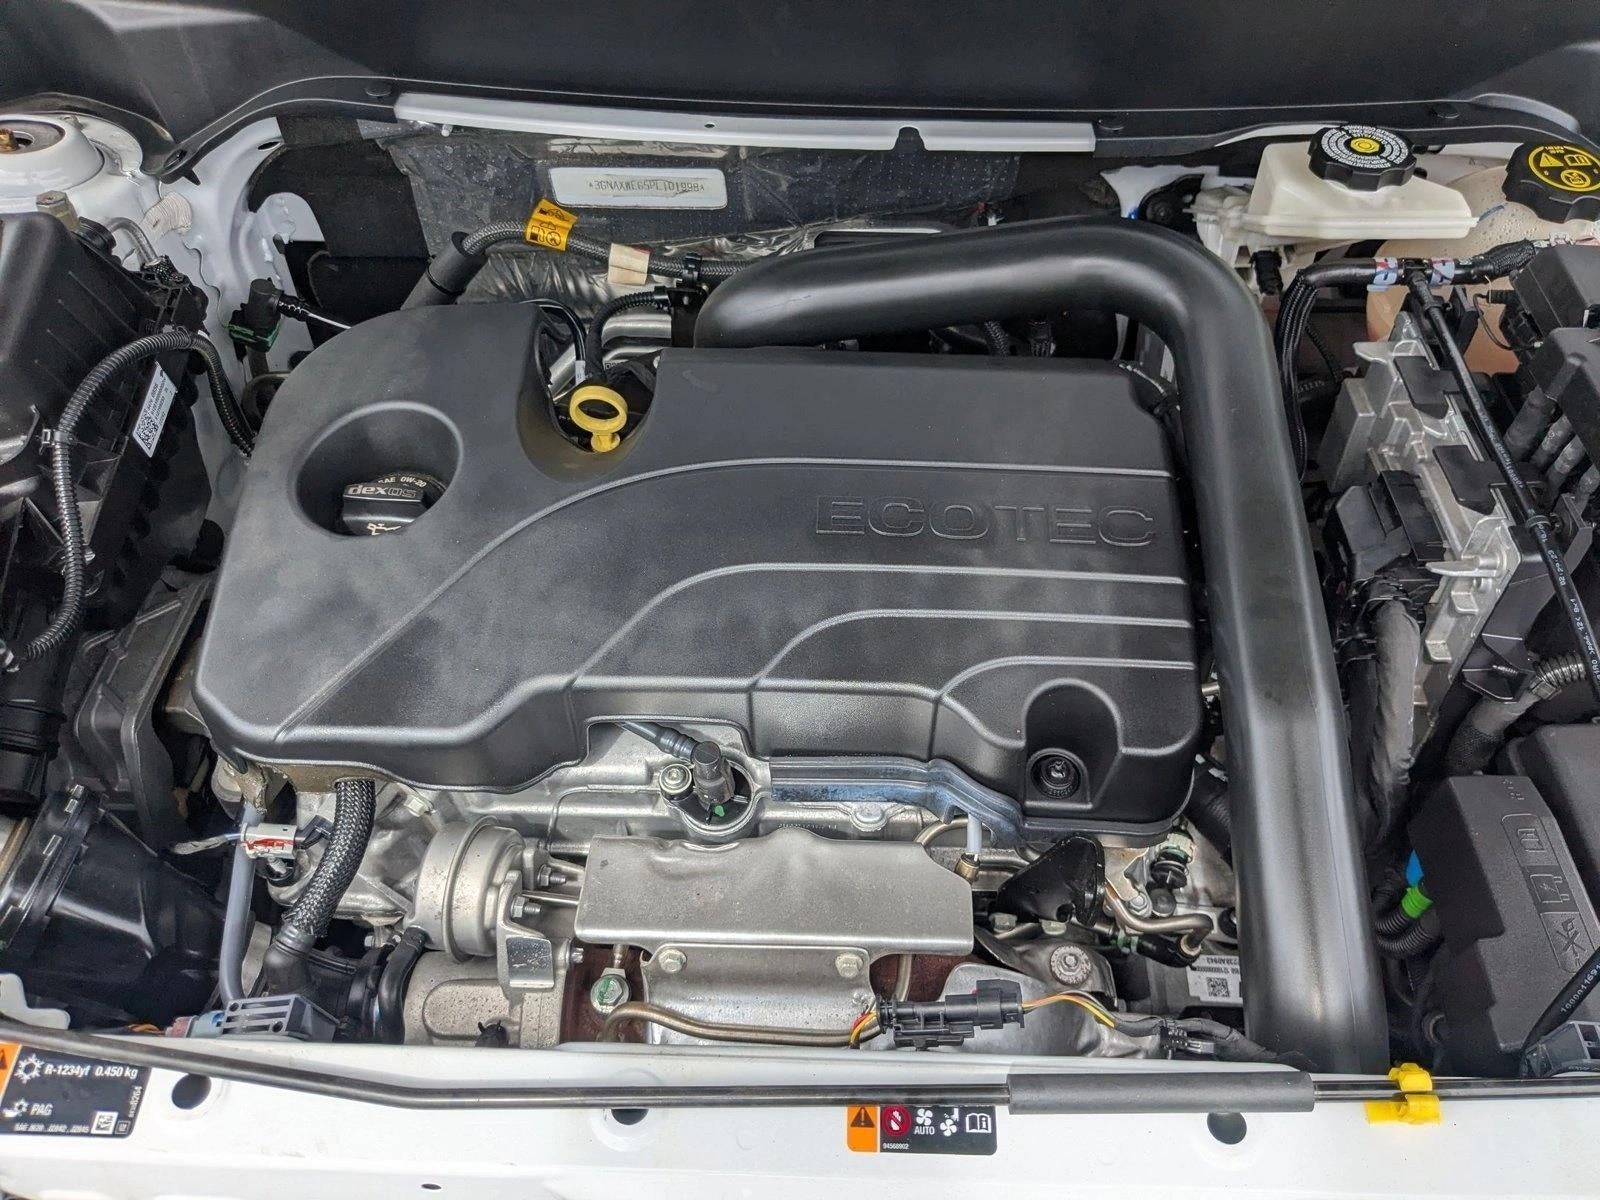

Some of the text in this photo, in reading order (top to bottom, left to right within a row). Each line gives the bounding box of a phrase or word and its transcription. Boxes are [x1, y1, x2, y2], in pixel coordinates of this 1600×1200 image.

[400, 476, 427, 488] 0W-20
[347, 484, 416, 498] dexos
[816, 496, 1153, 547] ECOTEC
[44, 1064, 139, 1080] R-1234yf 0.450 kg
[30, 1103, 54, 1116] PAG
[914, 1125, 936, 1136] AUTO
